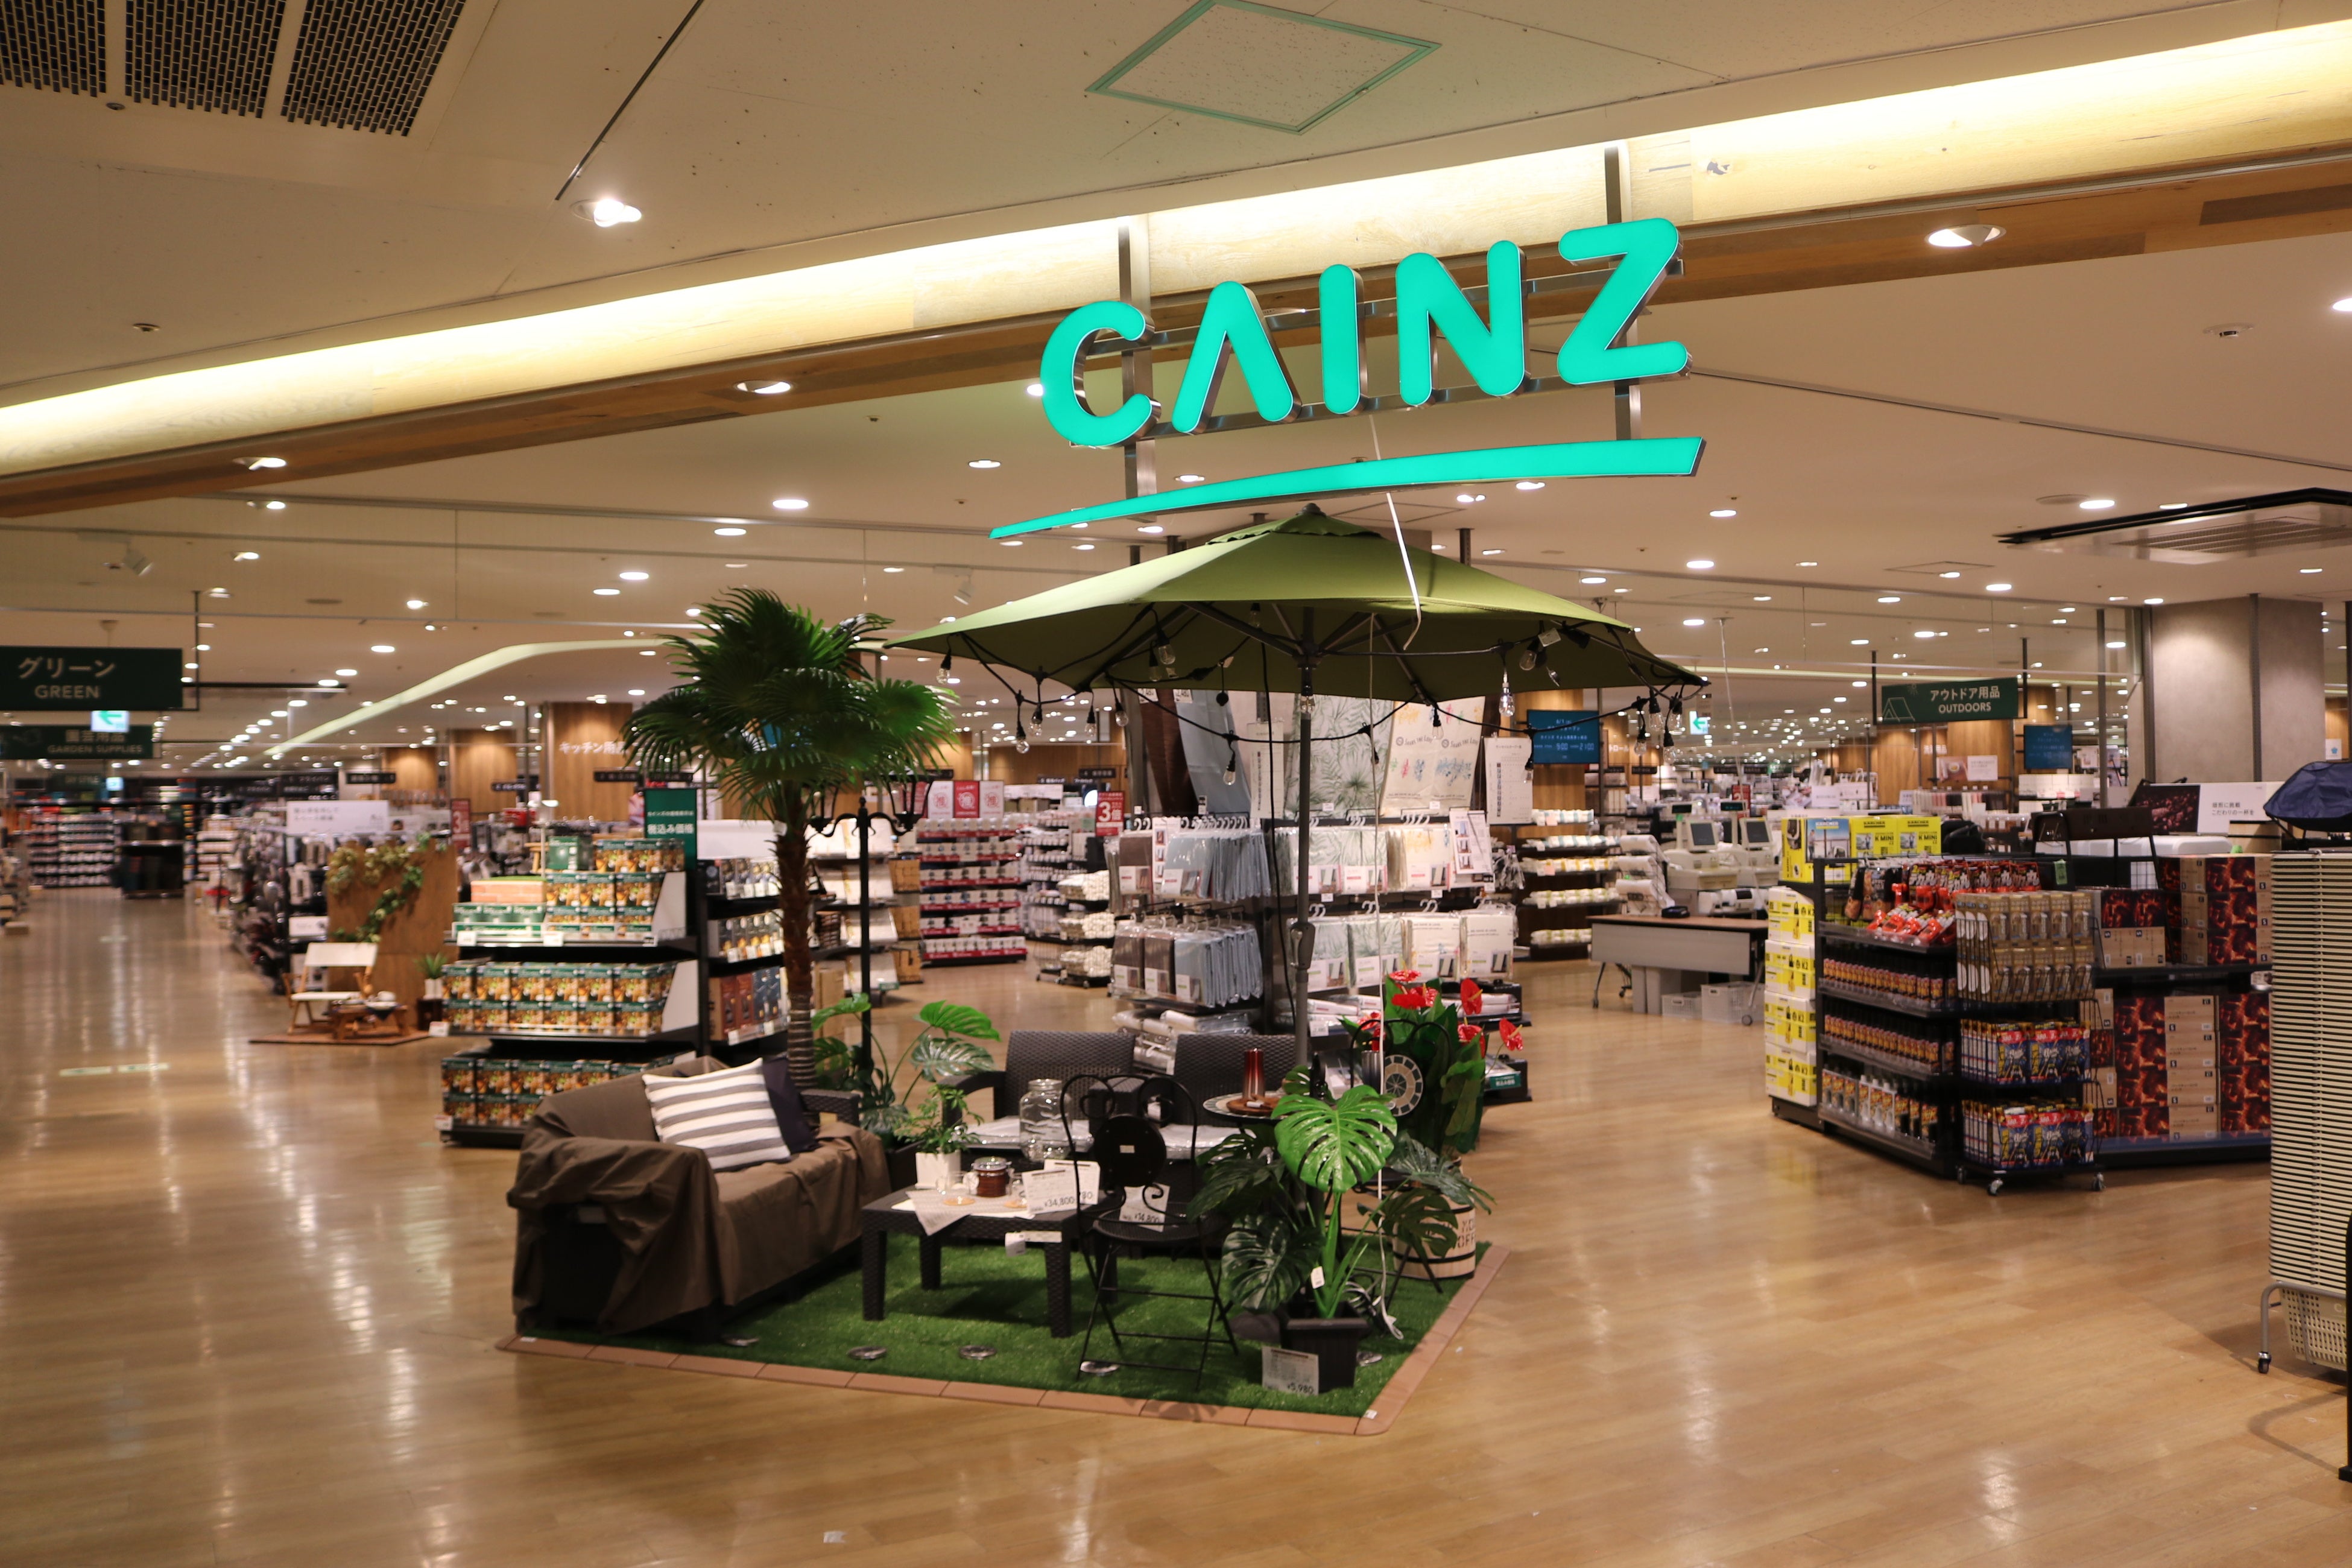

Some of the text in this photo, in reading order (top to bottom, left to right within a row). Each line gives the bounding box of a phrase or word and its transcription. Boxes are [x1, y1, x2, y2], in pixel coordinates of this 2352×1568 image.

[1040, 217, 1691, 447] CAINZ
[19, 656, 115, 679] グリーン
[34, 684, 101, 699] GREEN
[1930, 686, 2000, 701] アウトドア用品
[1938, 701, 1991, 714] OUTDOORS
[47, 744, 143, 754] GARDEN SUPPLIES
